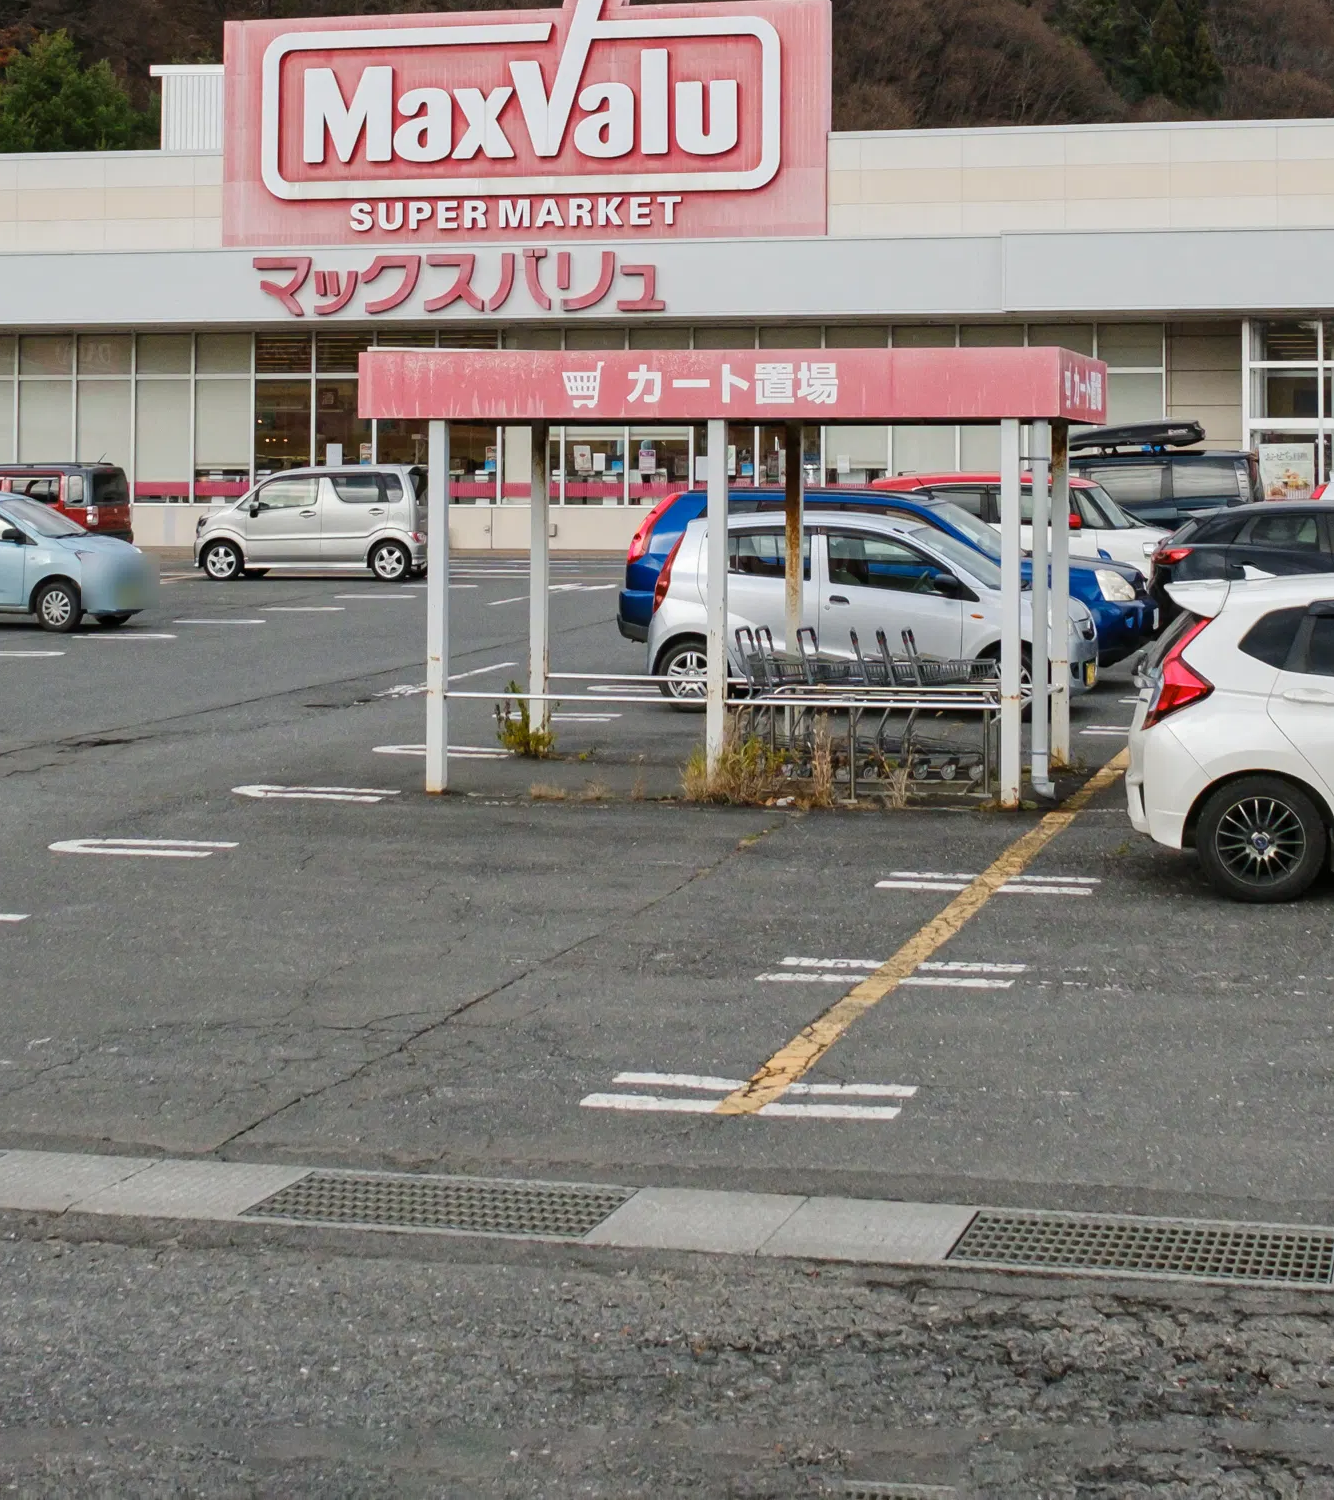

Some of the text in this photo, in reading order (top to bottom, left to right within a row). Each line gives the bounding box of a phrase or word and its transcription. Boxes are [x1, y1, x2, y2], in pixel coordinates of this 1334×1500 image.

[349, 195, 683, 232] SUPER MARKET
[252, 248, 667, 317] マックスバリュ
[626, 362, 839, 405] カート置場
